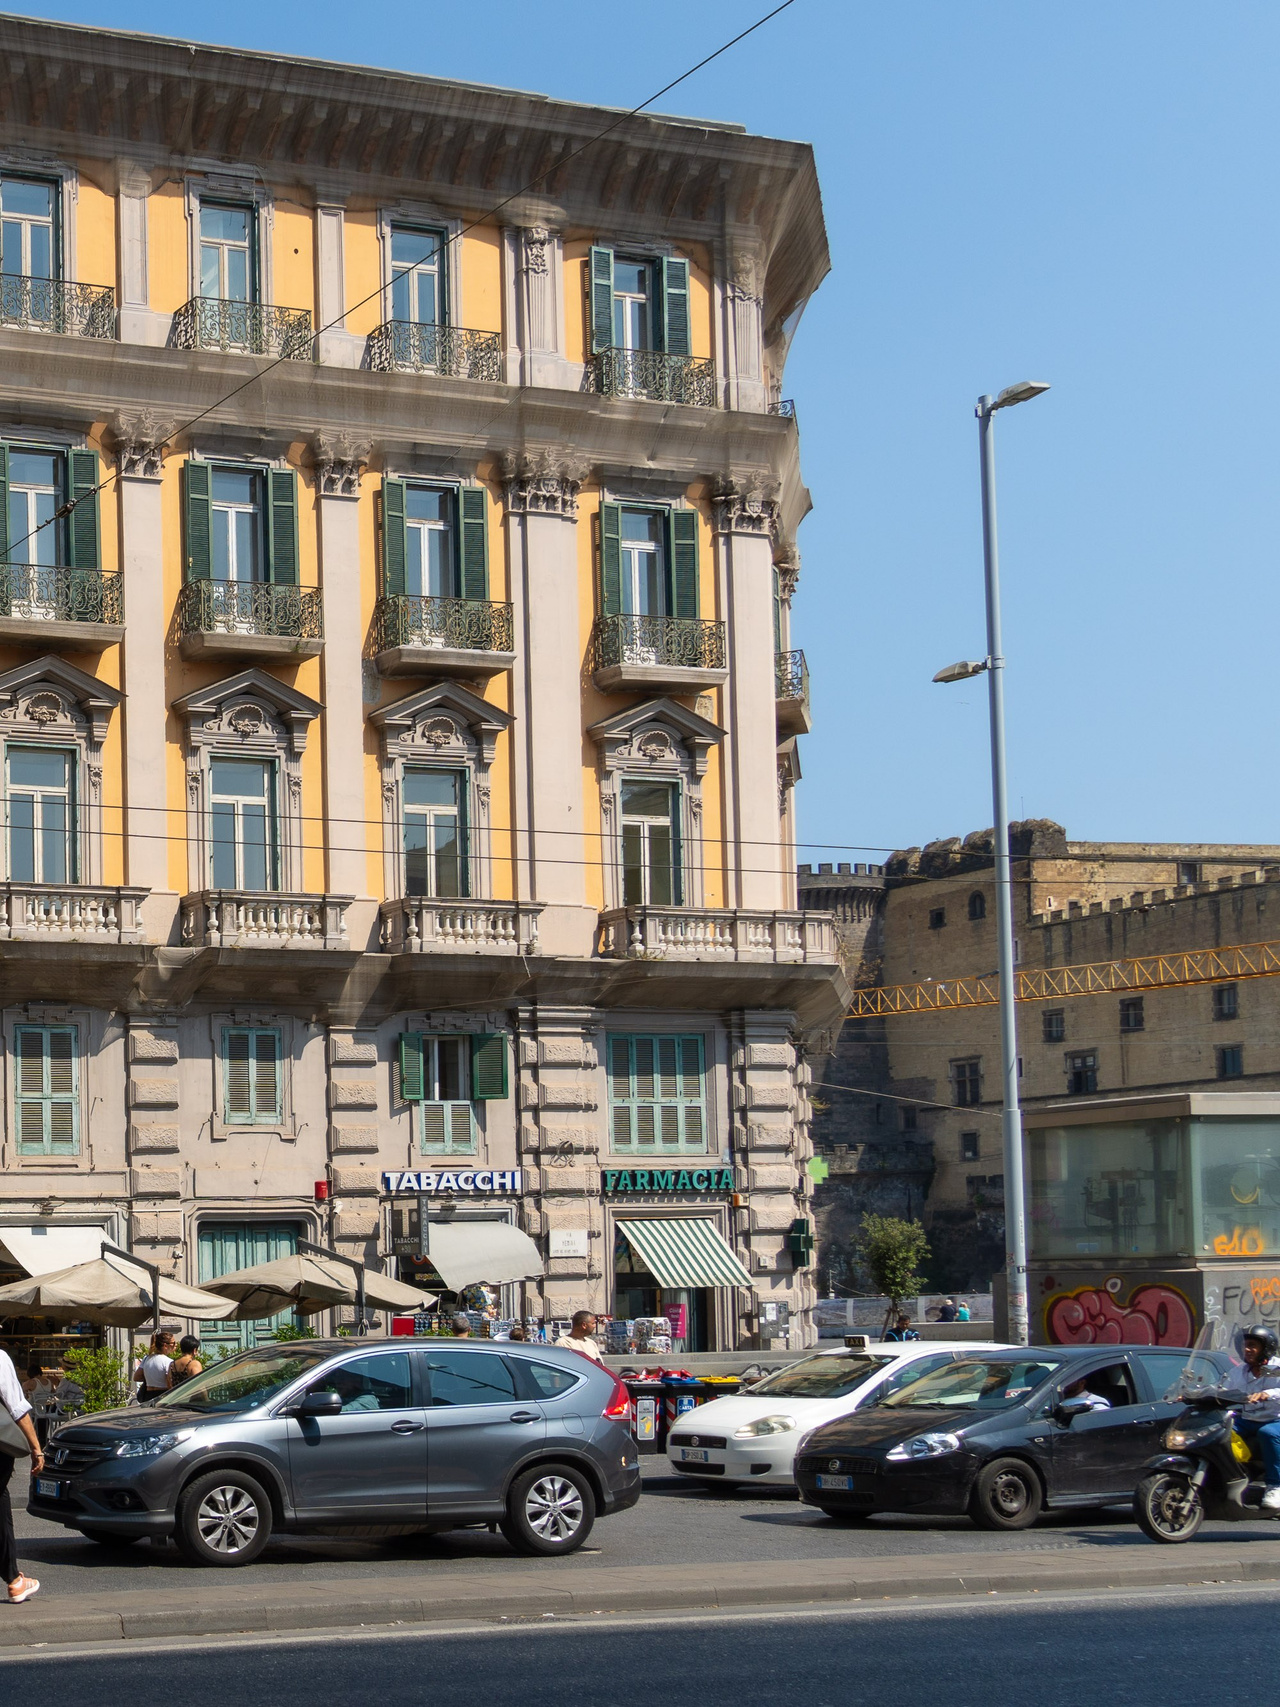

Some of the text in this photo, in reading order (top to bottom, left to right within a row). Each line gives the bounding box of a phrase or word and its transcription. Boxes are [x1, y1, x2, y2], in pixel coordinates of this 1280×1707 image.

[384, 1171, 522, 1190] TABACCHI
[604, 1169, 736, 1190] FARMACIA
[846, 1338, 864, 1346] TAXI
